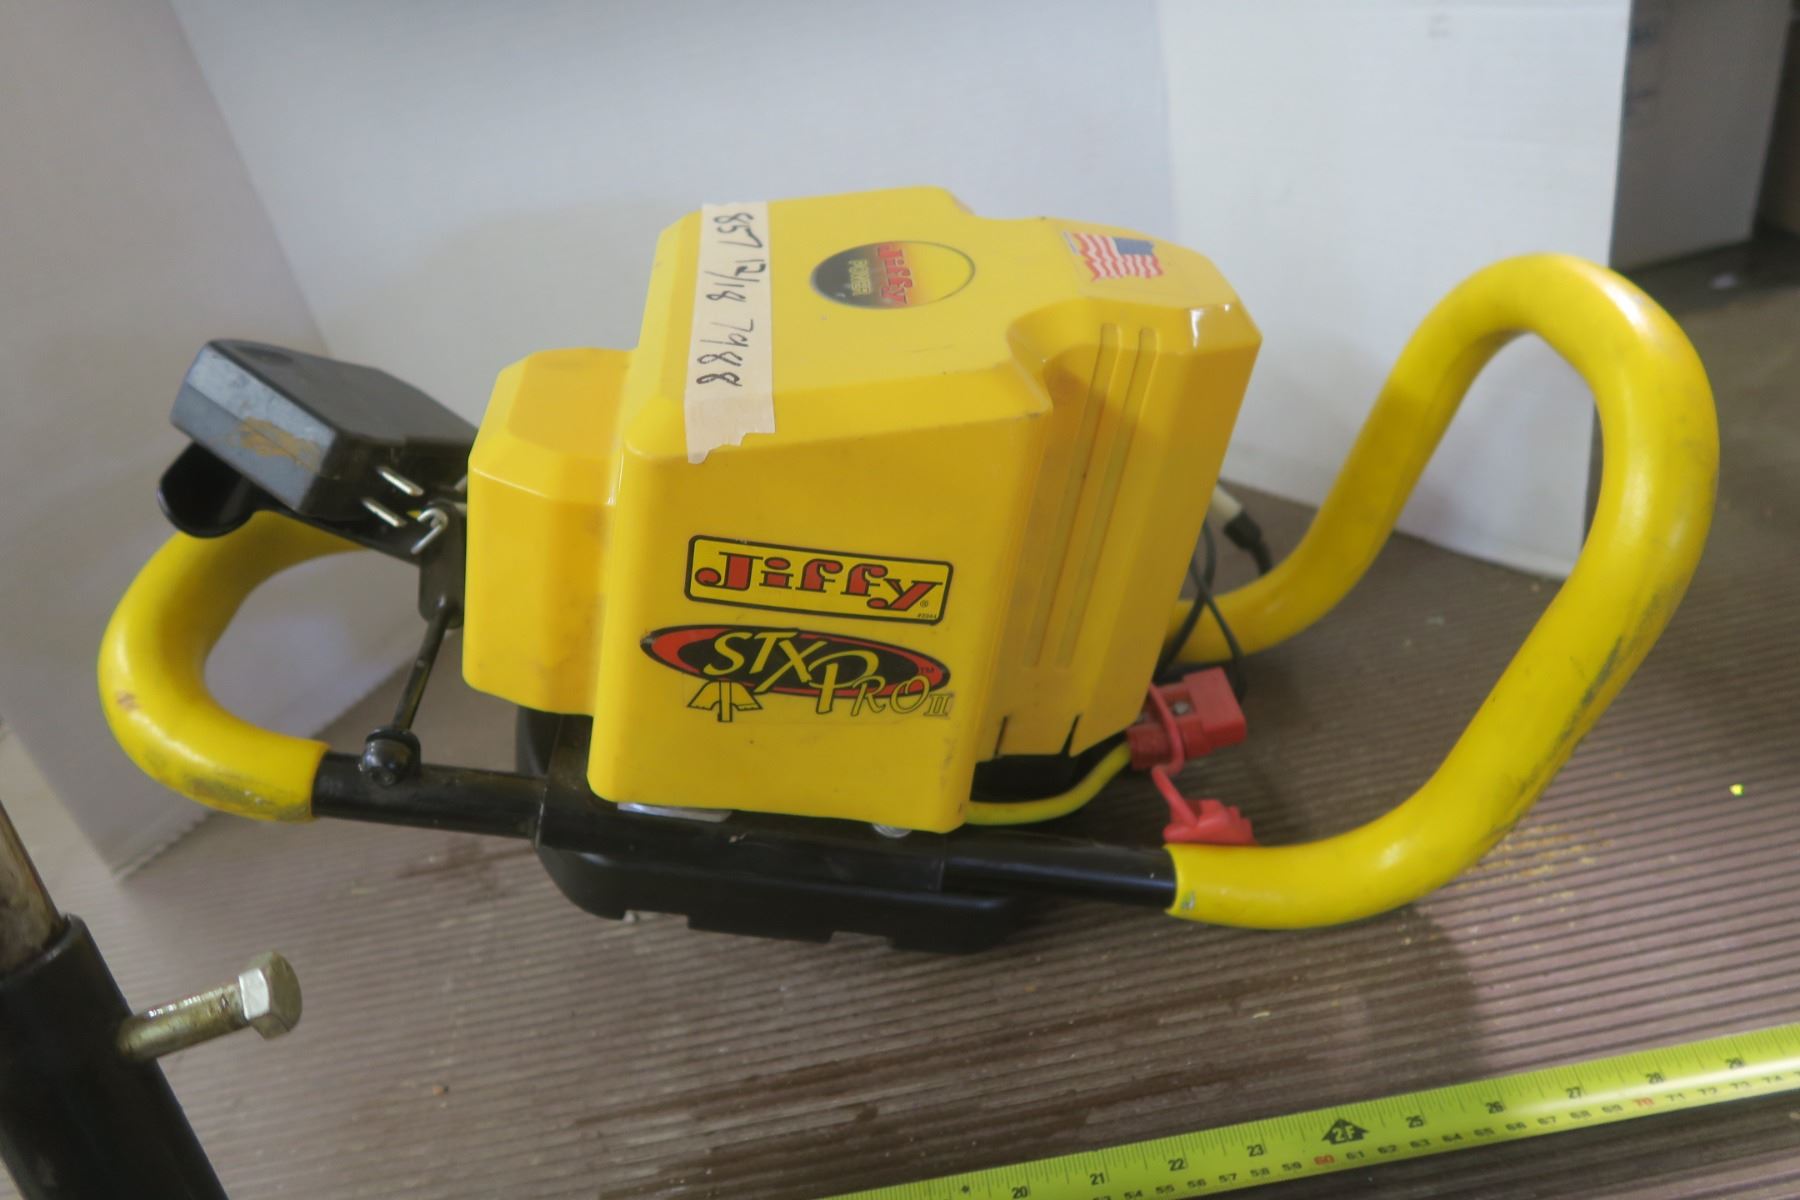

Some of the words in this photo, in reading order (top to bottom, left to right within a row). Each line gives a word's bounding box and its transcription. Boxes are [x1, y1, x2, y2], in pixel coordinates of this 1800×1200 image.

[713, 212, 763, 249] 857
[695, 318, 754, 388] 7988
[694, 550, 942, 612] Jiffy
[704, 628, 828, 695] STX
[1011, 1185, 1029, 1200] 20
[1090, 1172, 1106, 1186] 21
[1168, 1159, 1184, 1171] 22
[1247, 1144, 1264, 1157] 23
[1406, 1115, 1423, 1128] 25
[1485, 1101, 1504, 1114] 26
[1565, 1086, 1583, 1099] 27
